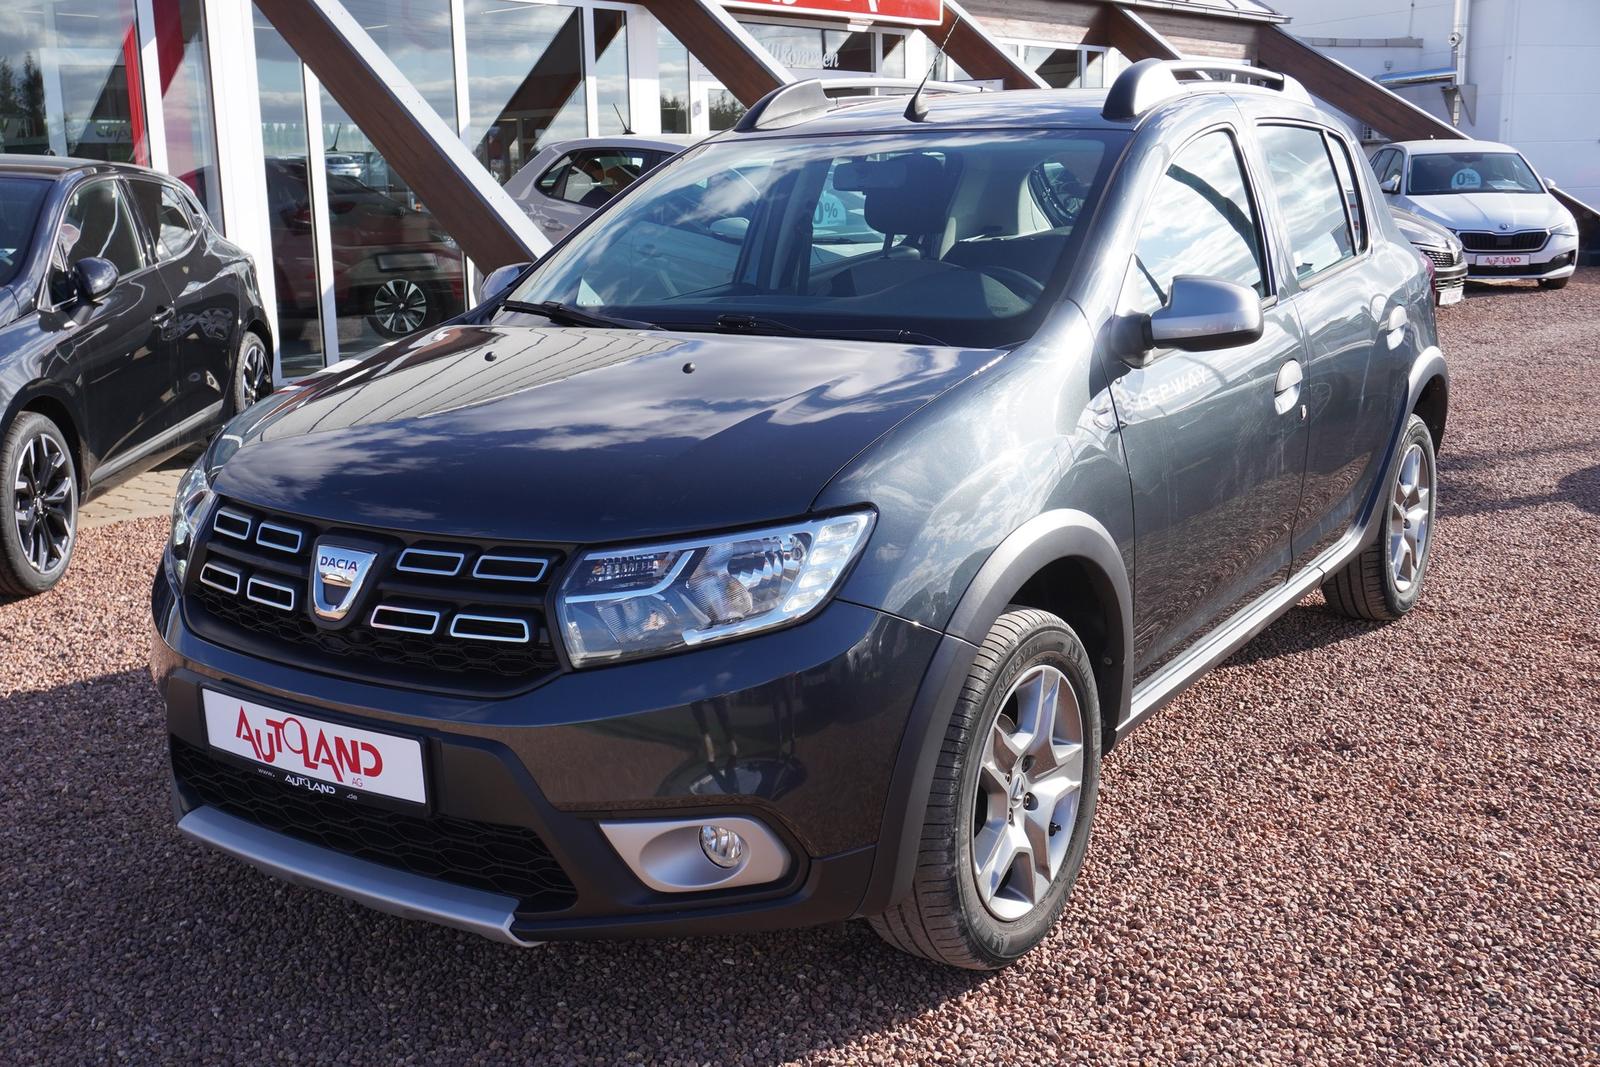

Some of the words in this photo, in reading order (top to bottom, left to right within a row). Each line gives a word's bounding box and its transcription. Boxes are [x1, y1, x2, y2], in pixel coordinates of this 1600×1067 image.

[1457, 172, 1476, 186] 0%
[320, 556, 357, 572] DACIA
[235, 705, 383, 783] AUTOLAND
[284, 774, 336, 794] AUTOLAND
[351, 777, 363, 788] AG
